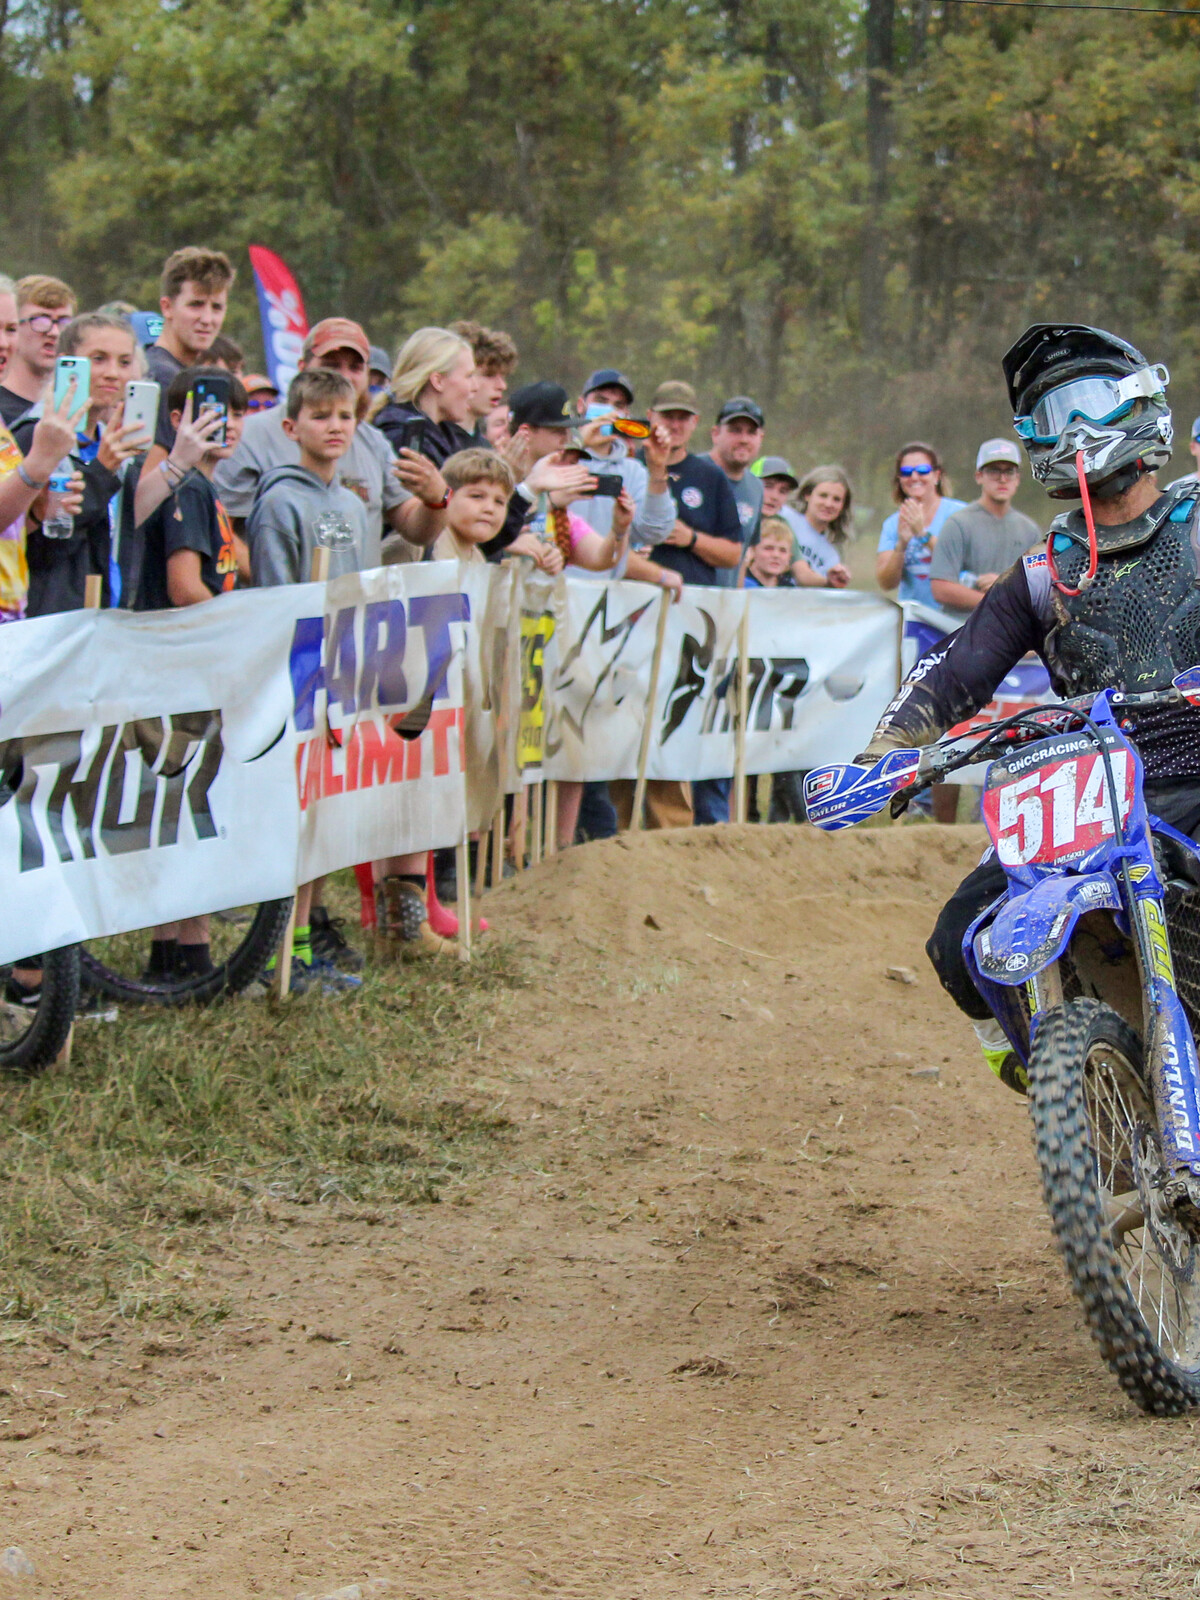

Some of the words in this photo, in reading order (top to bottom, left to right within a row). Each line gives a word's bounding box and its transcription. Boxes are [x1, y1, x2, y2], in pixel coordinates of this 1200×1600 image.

[290, 593, 471, 732] PART
[0, 709, 225, 874] THOR
[997, 750, 1131, 866] 514
[1007, 735, 1116, 774] GNCCRACING.CM
[1161, 1031, 1195, 1153] DUNLOP
